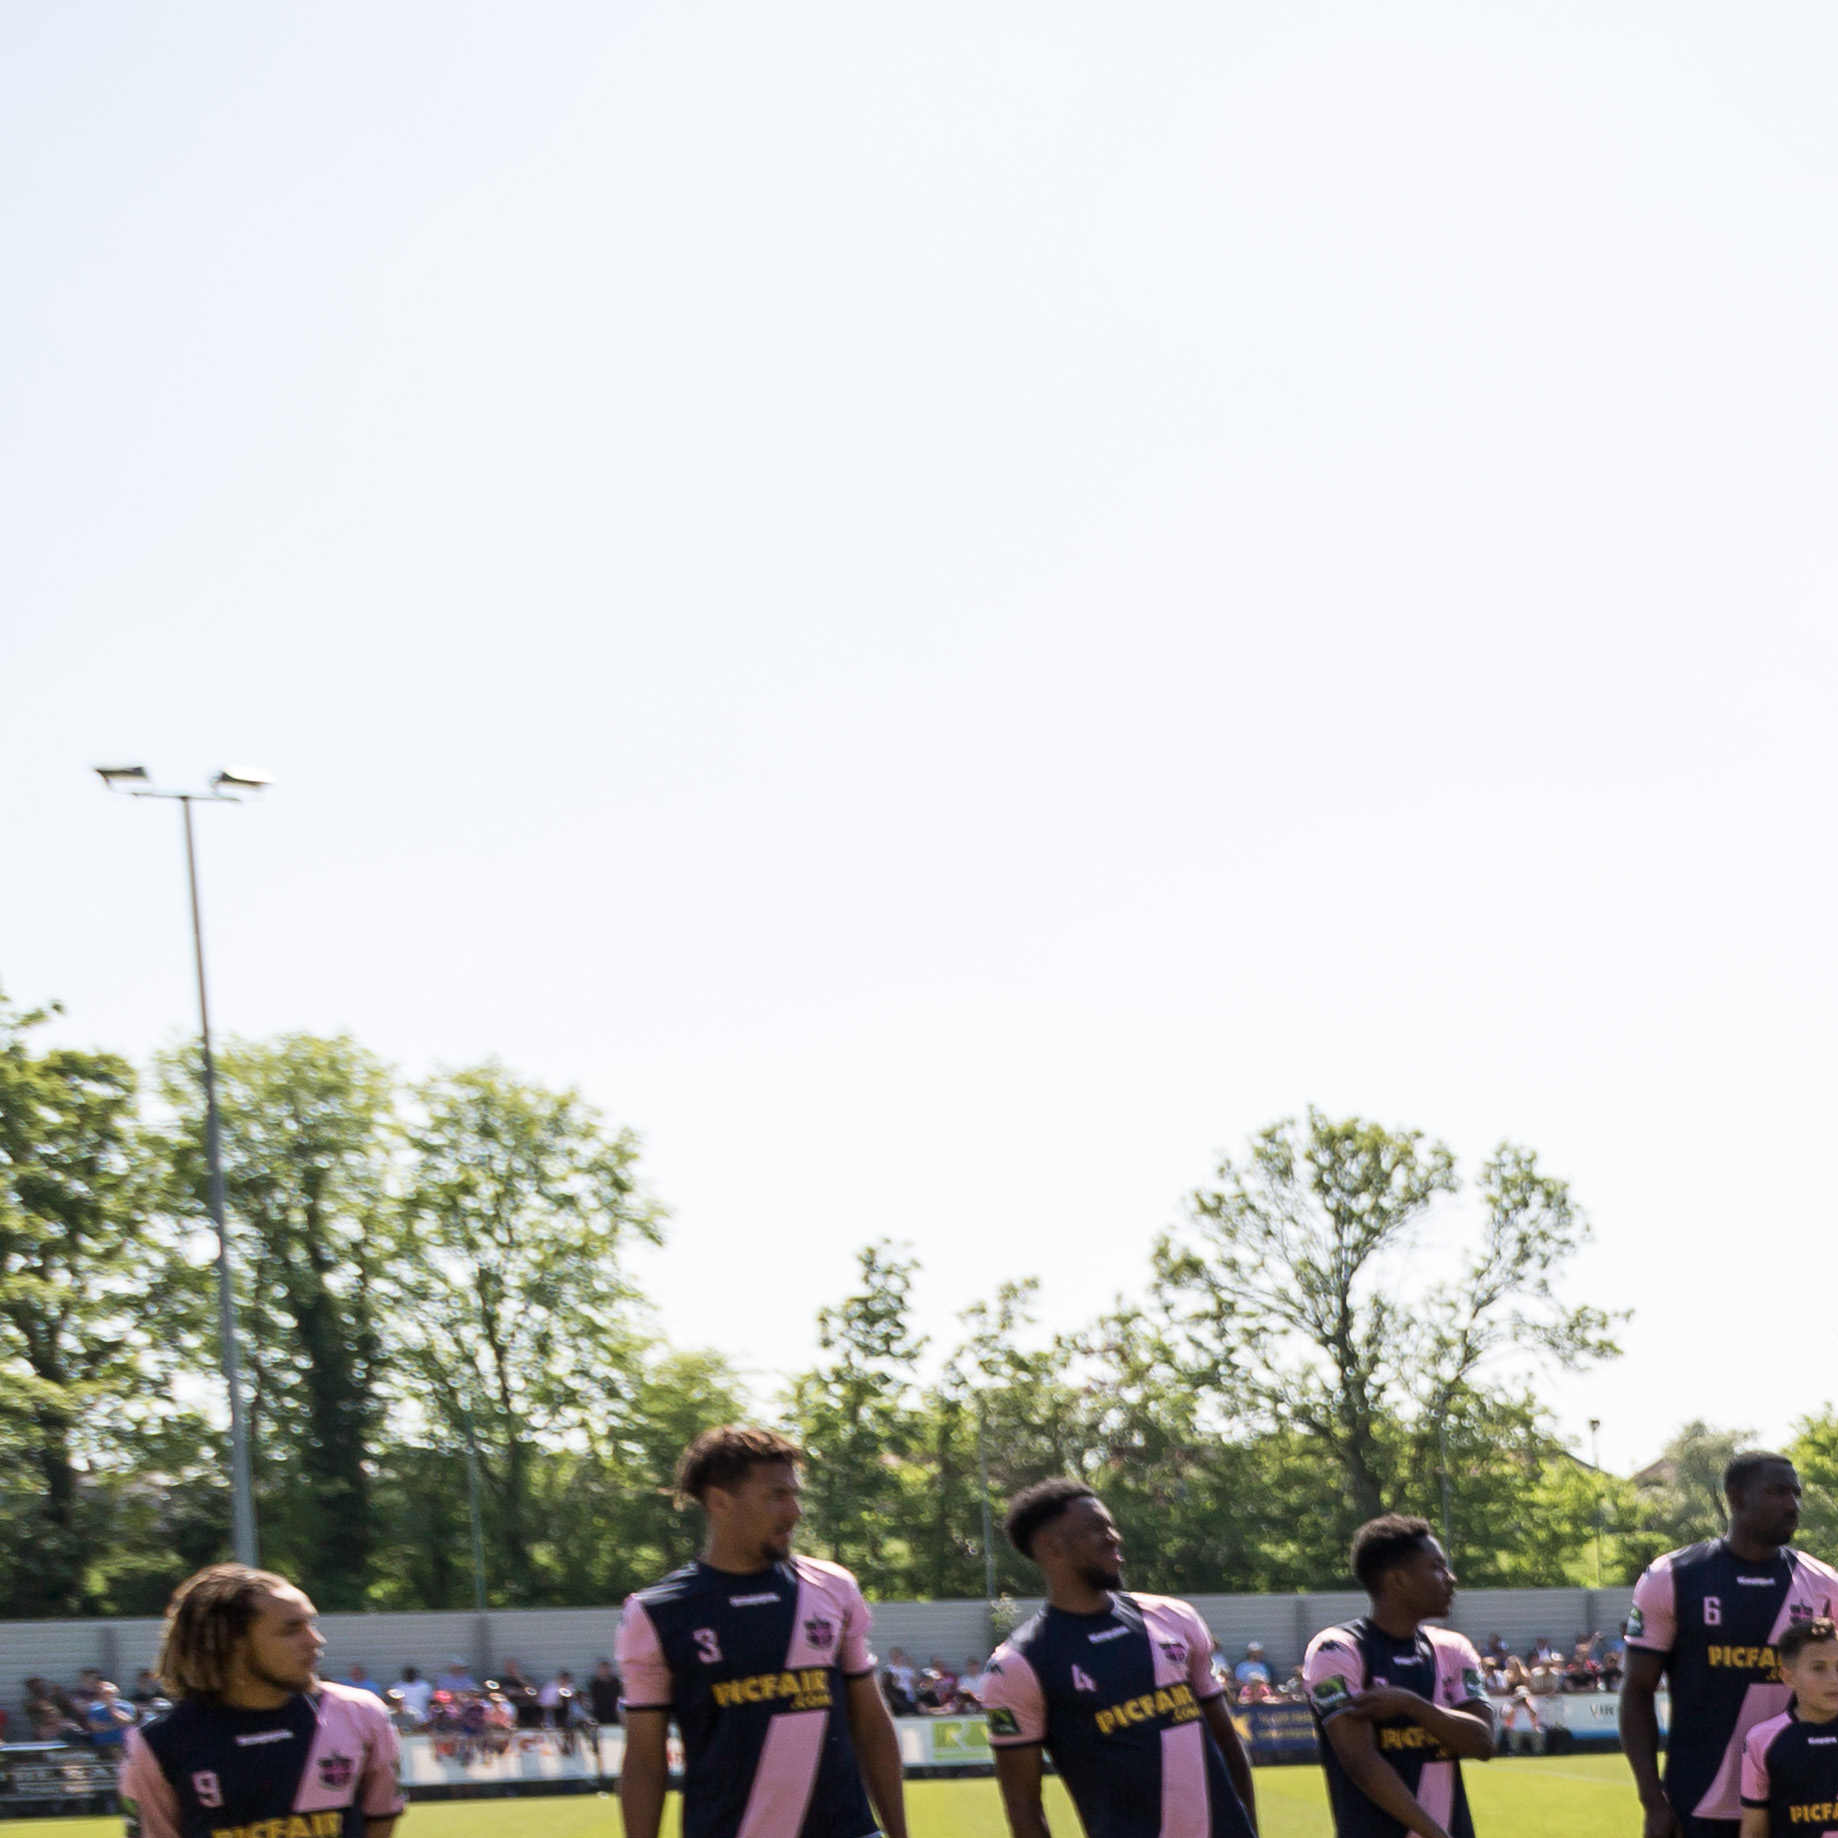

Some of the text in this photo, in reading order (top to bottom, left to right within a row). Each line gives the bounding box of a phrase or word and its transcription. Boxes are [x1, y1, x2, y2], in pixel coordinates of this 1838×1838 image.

[1703, 1596, 1722, 1626] 6
[693, 1628, 723, 1664] 3
[1708, 1645, 1782, 1668] PICFA
[710, 1668, 829, 1707] PICFAIR
[1071, 1664, 1097, 1692] 4
[192, 1770, 224, 1808] 9
